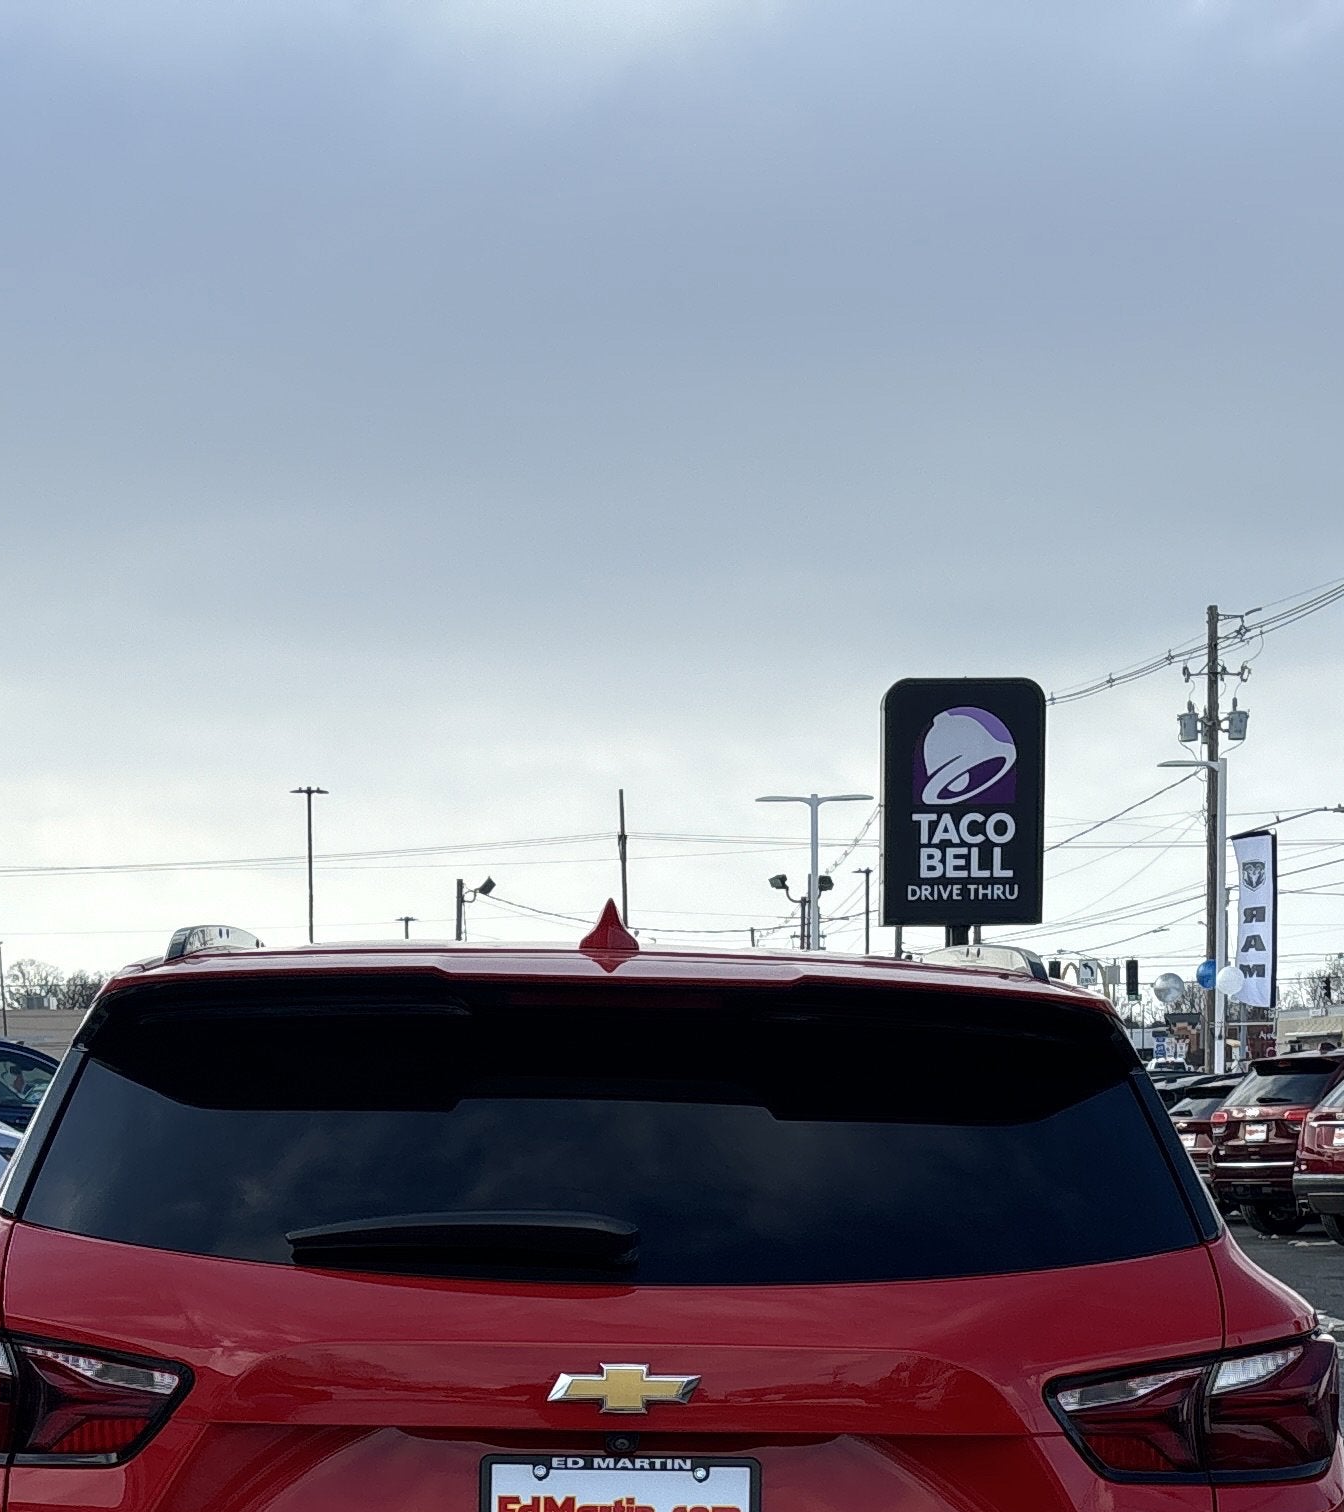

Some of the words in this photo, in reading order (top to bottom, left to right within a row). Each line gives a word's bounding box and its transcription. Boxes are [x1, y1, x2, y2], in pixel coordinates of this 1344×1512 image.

[911, 812, 1016, 844] TACO
[919, 846, 1014, 878] BELL
[907, 884, 961, 901] DRIVE
[967, 883, 1019, 900] THRU
[551, 1456, 585, 1469] ED
[592, 1457, 693, 1471] MARTIN
